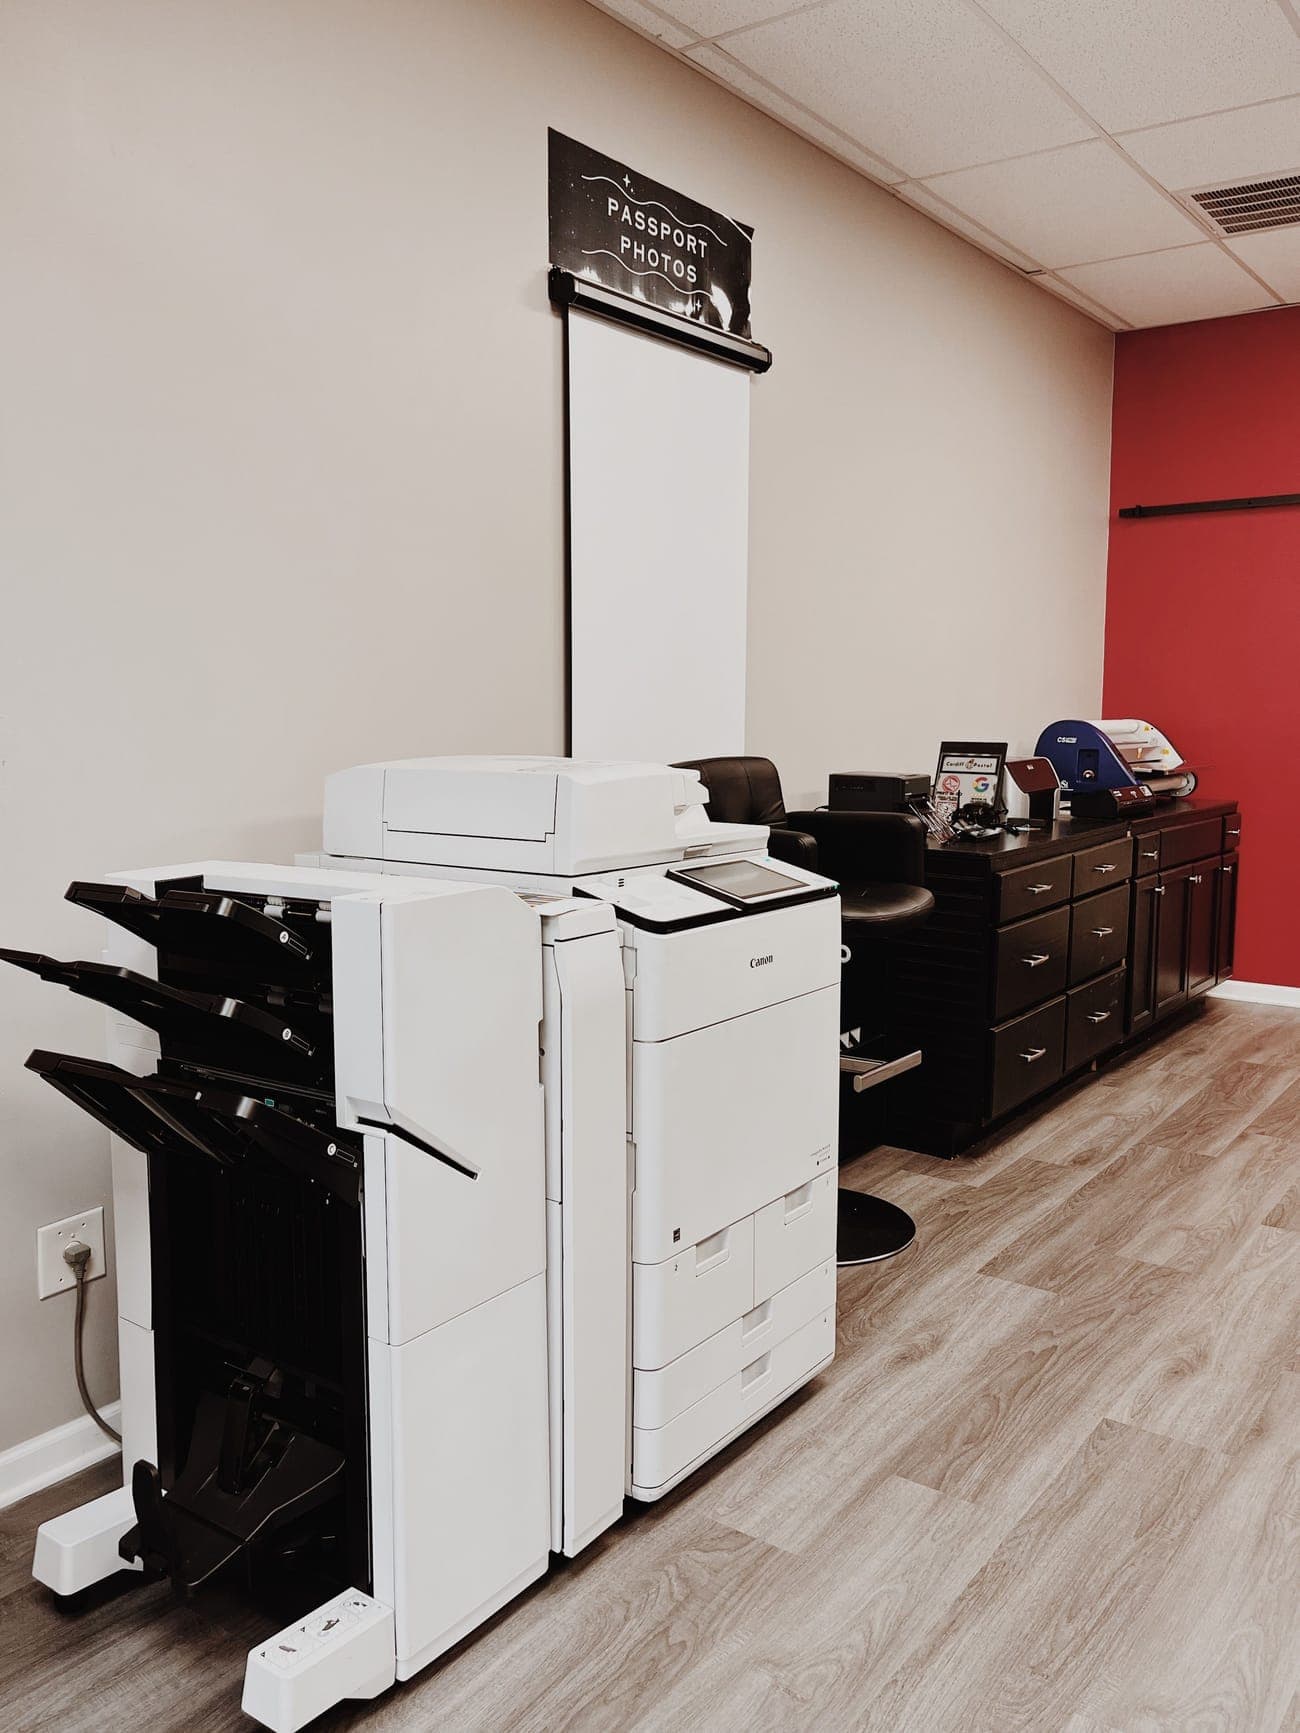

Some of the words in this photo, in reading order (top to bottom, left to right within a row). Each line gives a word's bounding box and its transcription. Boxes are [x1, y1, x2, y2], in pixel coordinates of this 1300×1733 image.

[607, 197, 708, 258] PASSPORT
[620, 235, 697, 283] PHOTOS
[750, 954, 774, 969] Canon
